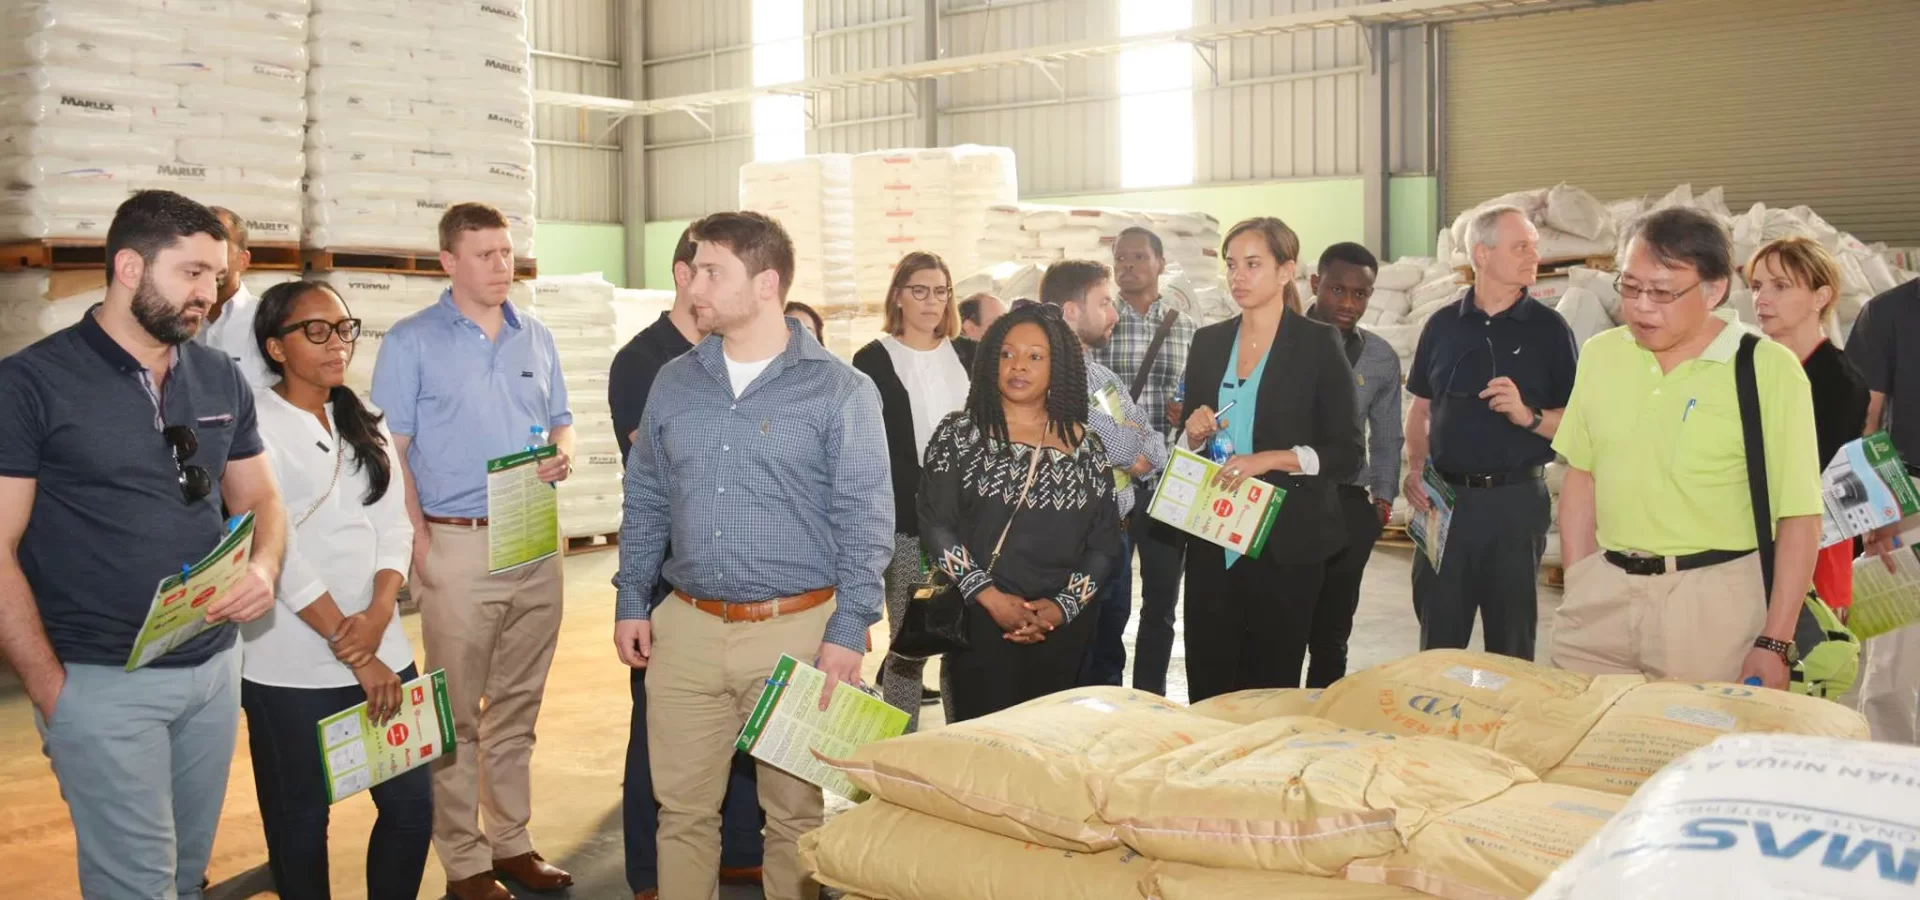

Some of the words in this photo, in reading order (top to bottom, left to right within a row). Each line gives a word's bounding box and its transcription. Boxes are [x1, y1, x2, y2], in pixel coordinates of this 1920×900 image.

[481, 4, 517, 19] MARLEX
[485, 59, 522, 74] MARLEX
[60, 96, 115, 111] MARLEX
[157, 164, 206, 178] MARLEX
[416, 198, 449, 209] MARL
[246, 220, 289, 232] MARLEX
